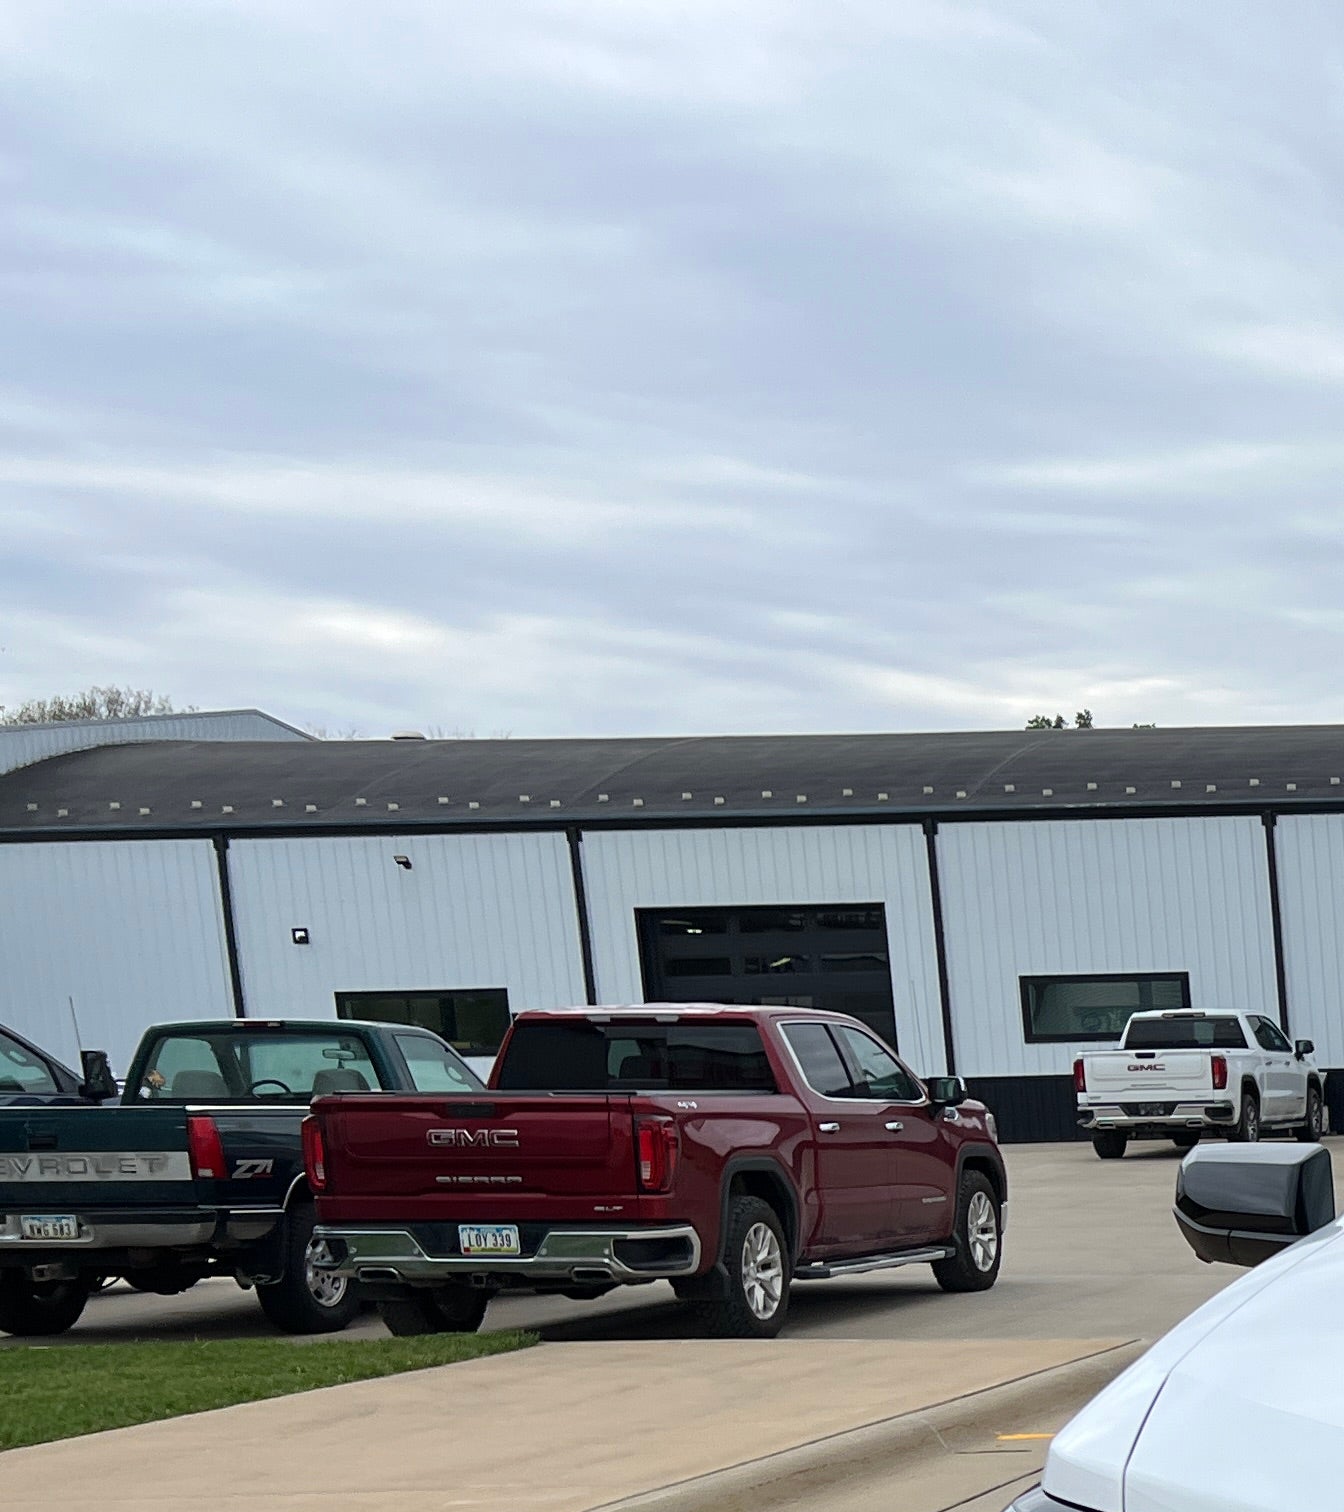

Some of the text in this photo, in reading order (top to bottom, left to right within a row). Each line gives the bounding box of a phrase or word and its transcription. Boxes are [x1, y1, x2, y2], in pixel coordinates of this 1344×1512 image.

[1127, 1063, 1166, 1071] GMC
[426, 1129, 519, 1147] GMC
[491, 1233, 512, 1248] 339
